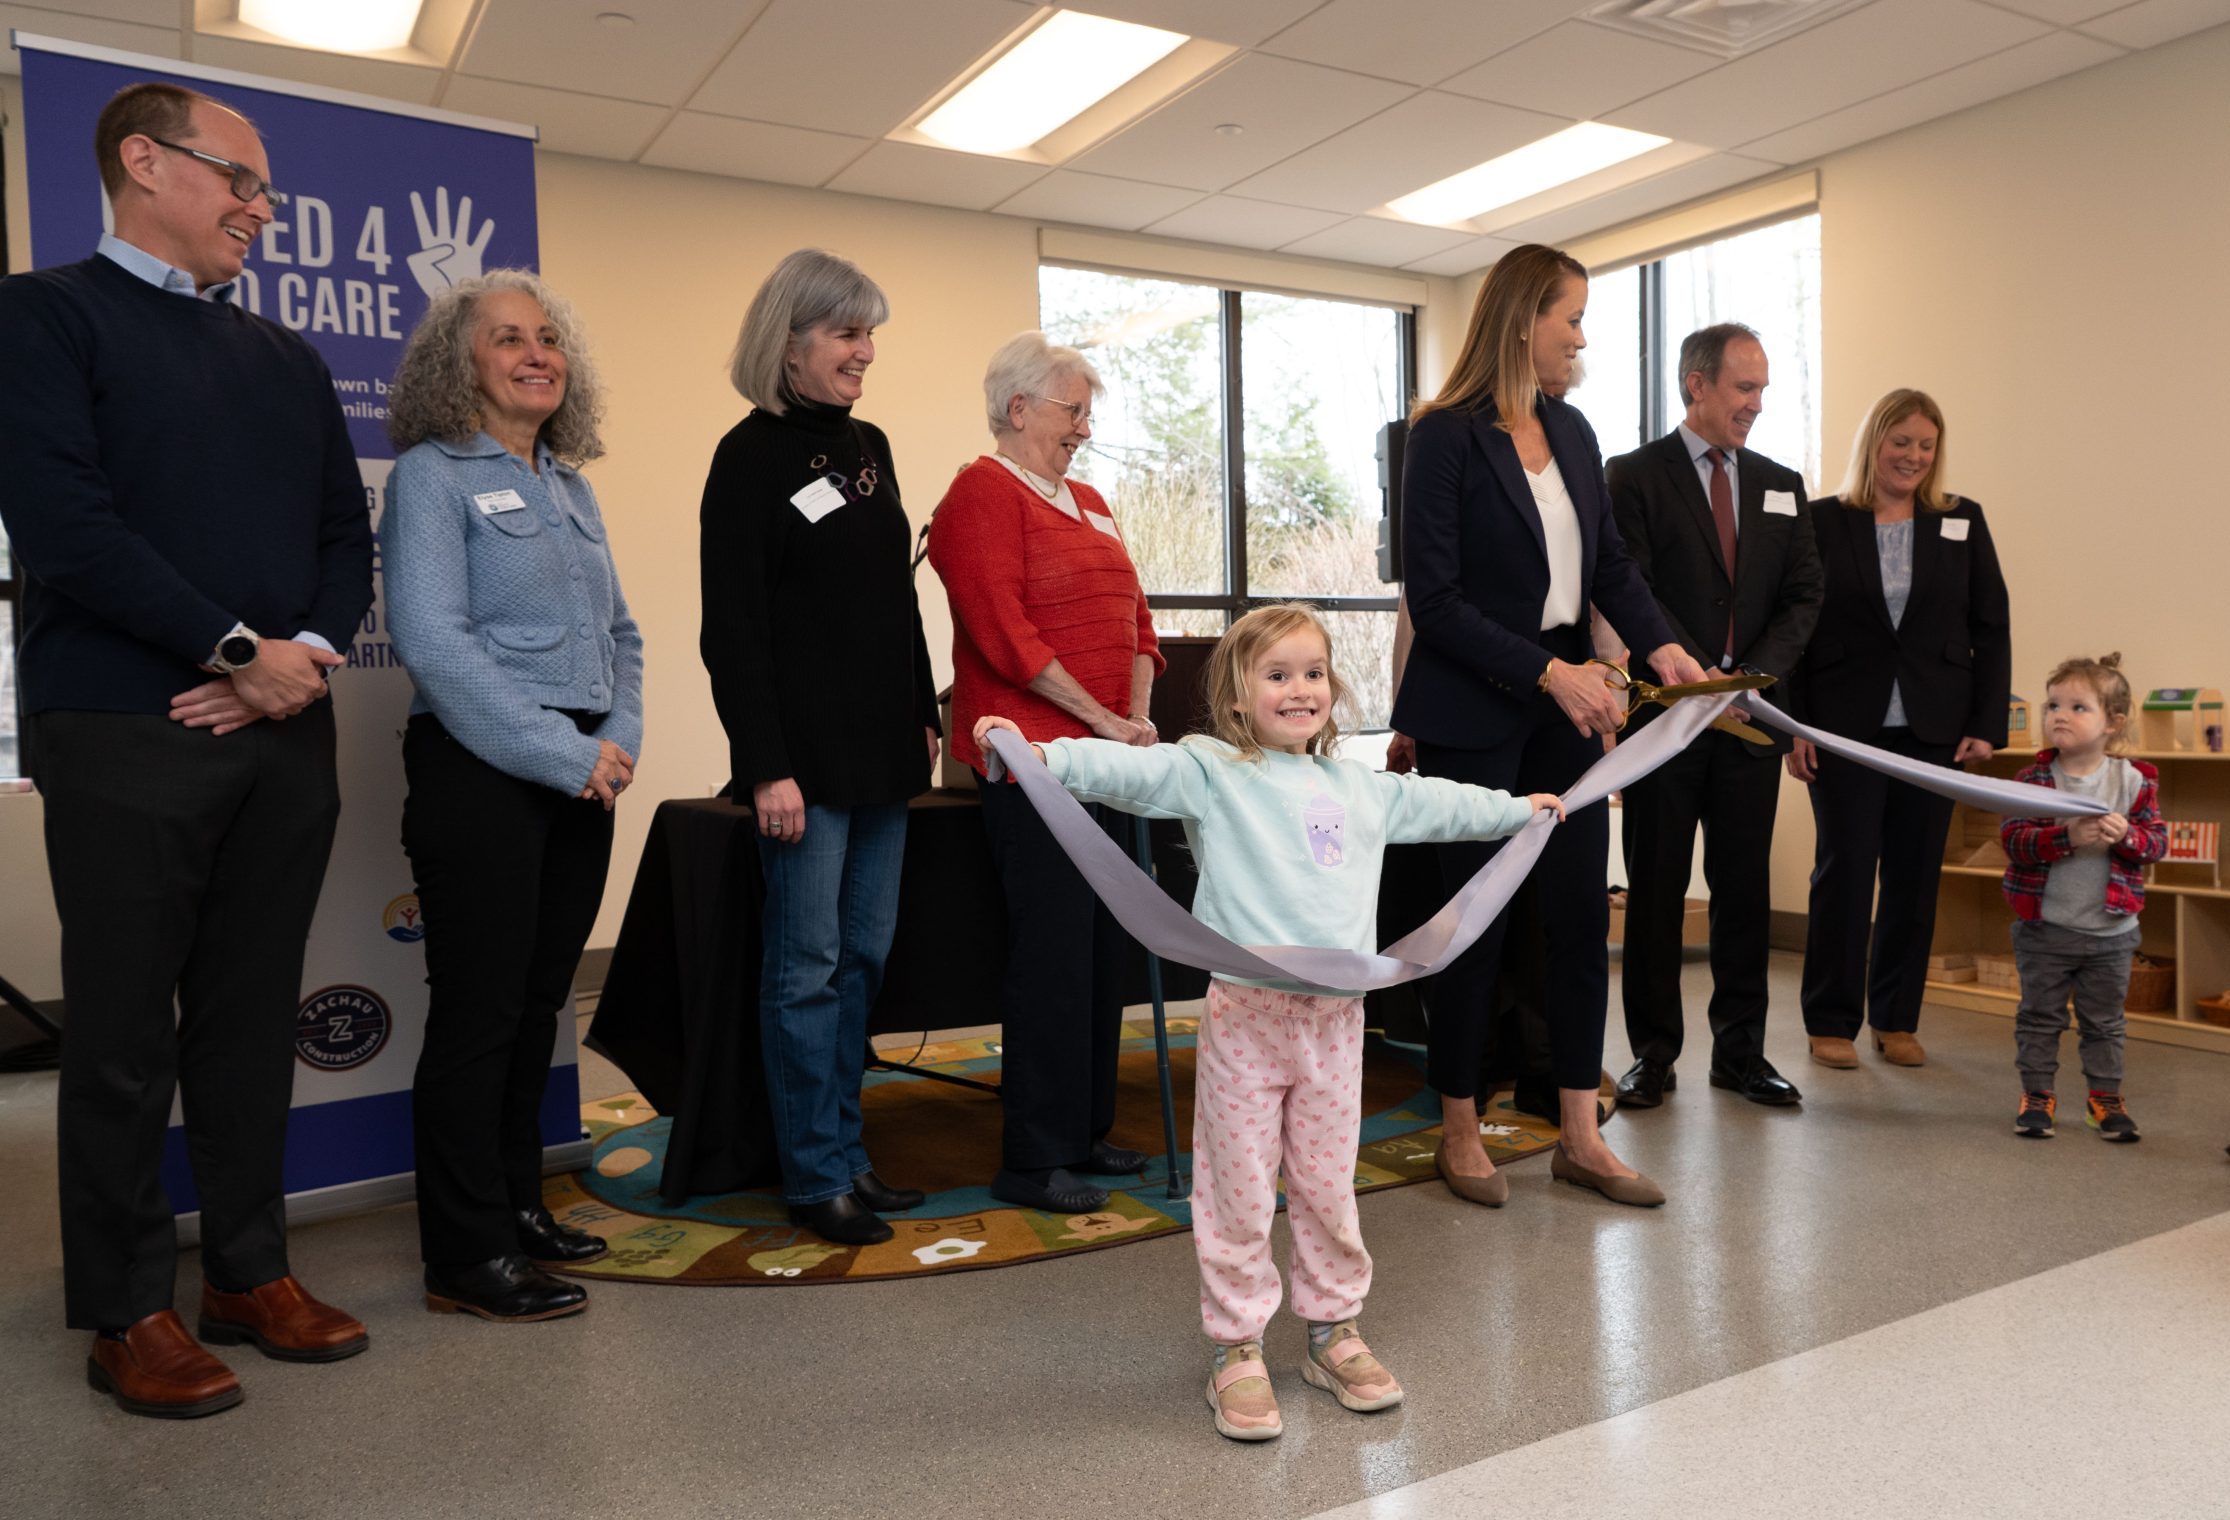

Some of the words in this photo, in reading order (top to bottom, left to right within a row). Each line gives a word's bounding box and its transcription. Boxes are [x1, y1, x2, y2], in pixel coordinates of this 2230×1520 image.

[356, 206, 392, 275] 4
[278, 272, 403, 340] CARE
[305, 996, 373, 1020] ZACHAU
[328, 1015, 354, 1043] Z
[302, 1031, 379, 1063] CONSTRUCTION
